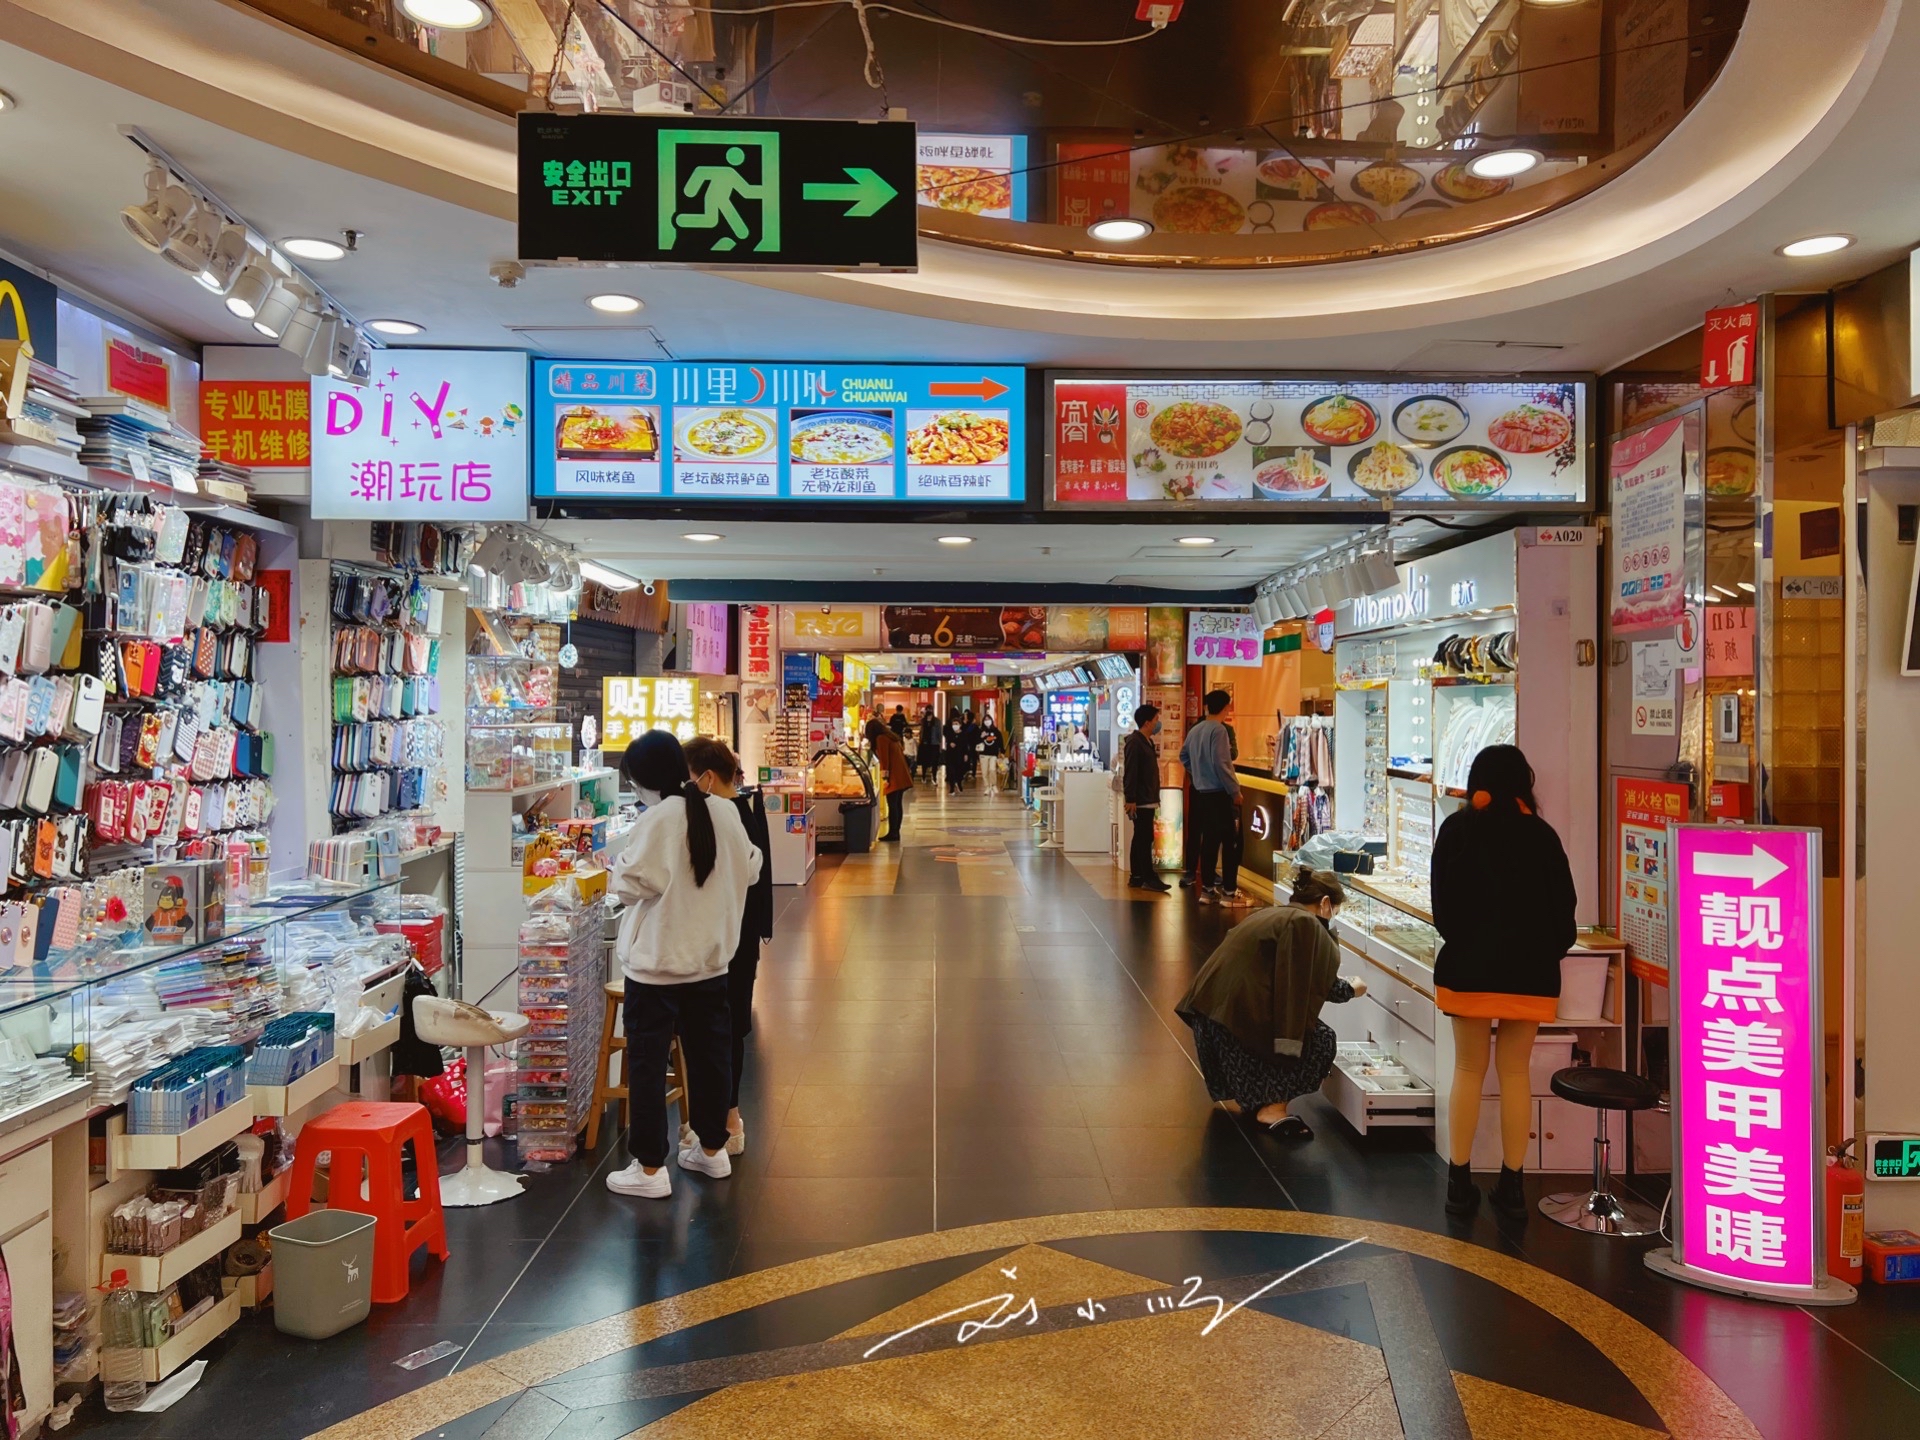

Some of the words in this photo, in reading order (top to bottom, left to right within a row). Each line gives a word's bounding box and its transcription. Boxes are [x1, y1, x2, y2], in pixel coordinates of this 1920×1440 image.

[542, 160, 632, 187] 安全出口
[552, 190, 623, 206] EXIT
[1708, 313, 1753, 331] 灭火筒
[554, 370, 651, 393] 精品川菜
[841, 378, 893, 390] CHUANLI
[204, 389, 310, 421] 专业贴膜
[841, 391, 908, 403] CHUANWAI
[325, 380, 451, 439] DIY
[205, 430, 310, 461] 手机维修
[1175, 459, 1219, 470] 香辣田鸡
[350, 459, 493, 502] 潮玩店
[575, 470, 636, 484] 风味烤鱼
[680, 472, 770, 486] 老坛酸菜鲈鱼
[809, 467, 870, 480] 老坛酸菜
[918, 474, 992, 487] 绝味香辣虾
[801, 480, 877, 493] 无骨龙利鱼
[1553, 530, 1583, 543] A020
[1803, 581, 1840, 595] C-026
[1353, 566, 1429, 628] Momoki
[909, 633, 932, 646] 每盘
[933, 615, 954, 648] 6
[955, 634, 974, 645] 元起
[1198, 614, 1235, 634] 专业
[607, 678, 695, 719] 贴膜
[1649, 708, 1673, 720] 禁止吸烟
[1624, 788, 1663, 811] 消火栓
[1699, 892, 1788, 1268] 靓点美甲美睫
[1875, 1159, 1902, 1167] 安全出口
[1876, 1167, 1900, 1175] EXIT
